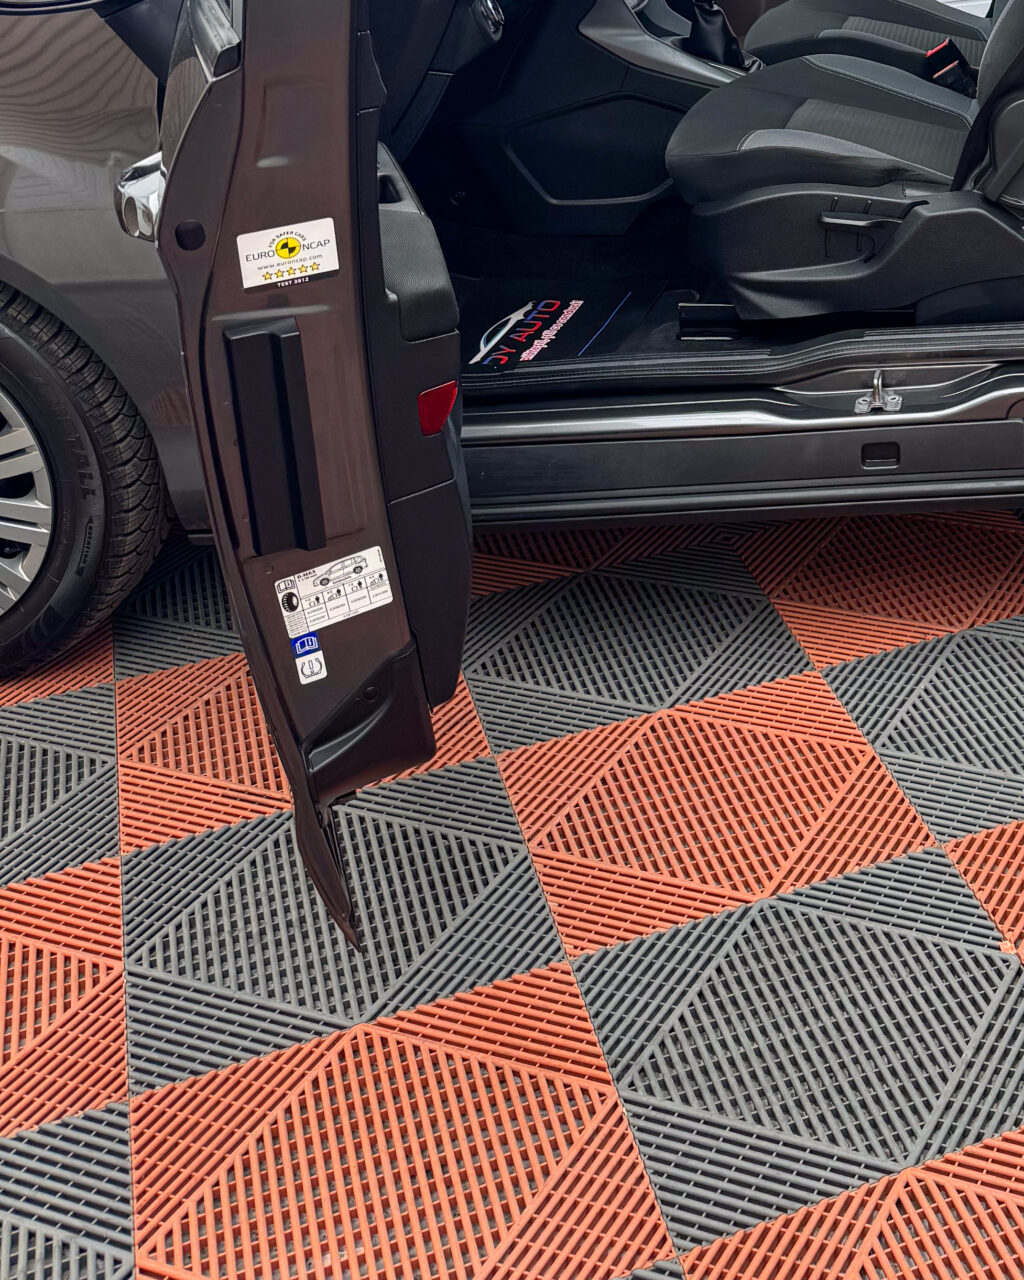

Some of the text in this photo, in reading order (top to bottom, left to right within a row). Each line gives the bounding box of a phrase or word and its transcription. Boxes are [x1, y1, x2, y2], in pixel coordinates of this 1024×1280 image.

[276, 231, 294, 239] SAFER
[245, 239, 330, 262] EURO NCAP
[257, 254, 323, 271] www.euroncap.com
[276, 279, 292, 287] TEST
[509, 300, 560, 342] AUTO
